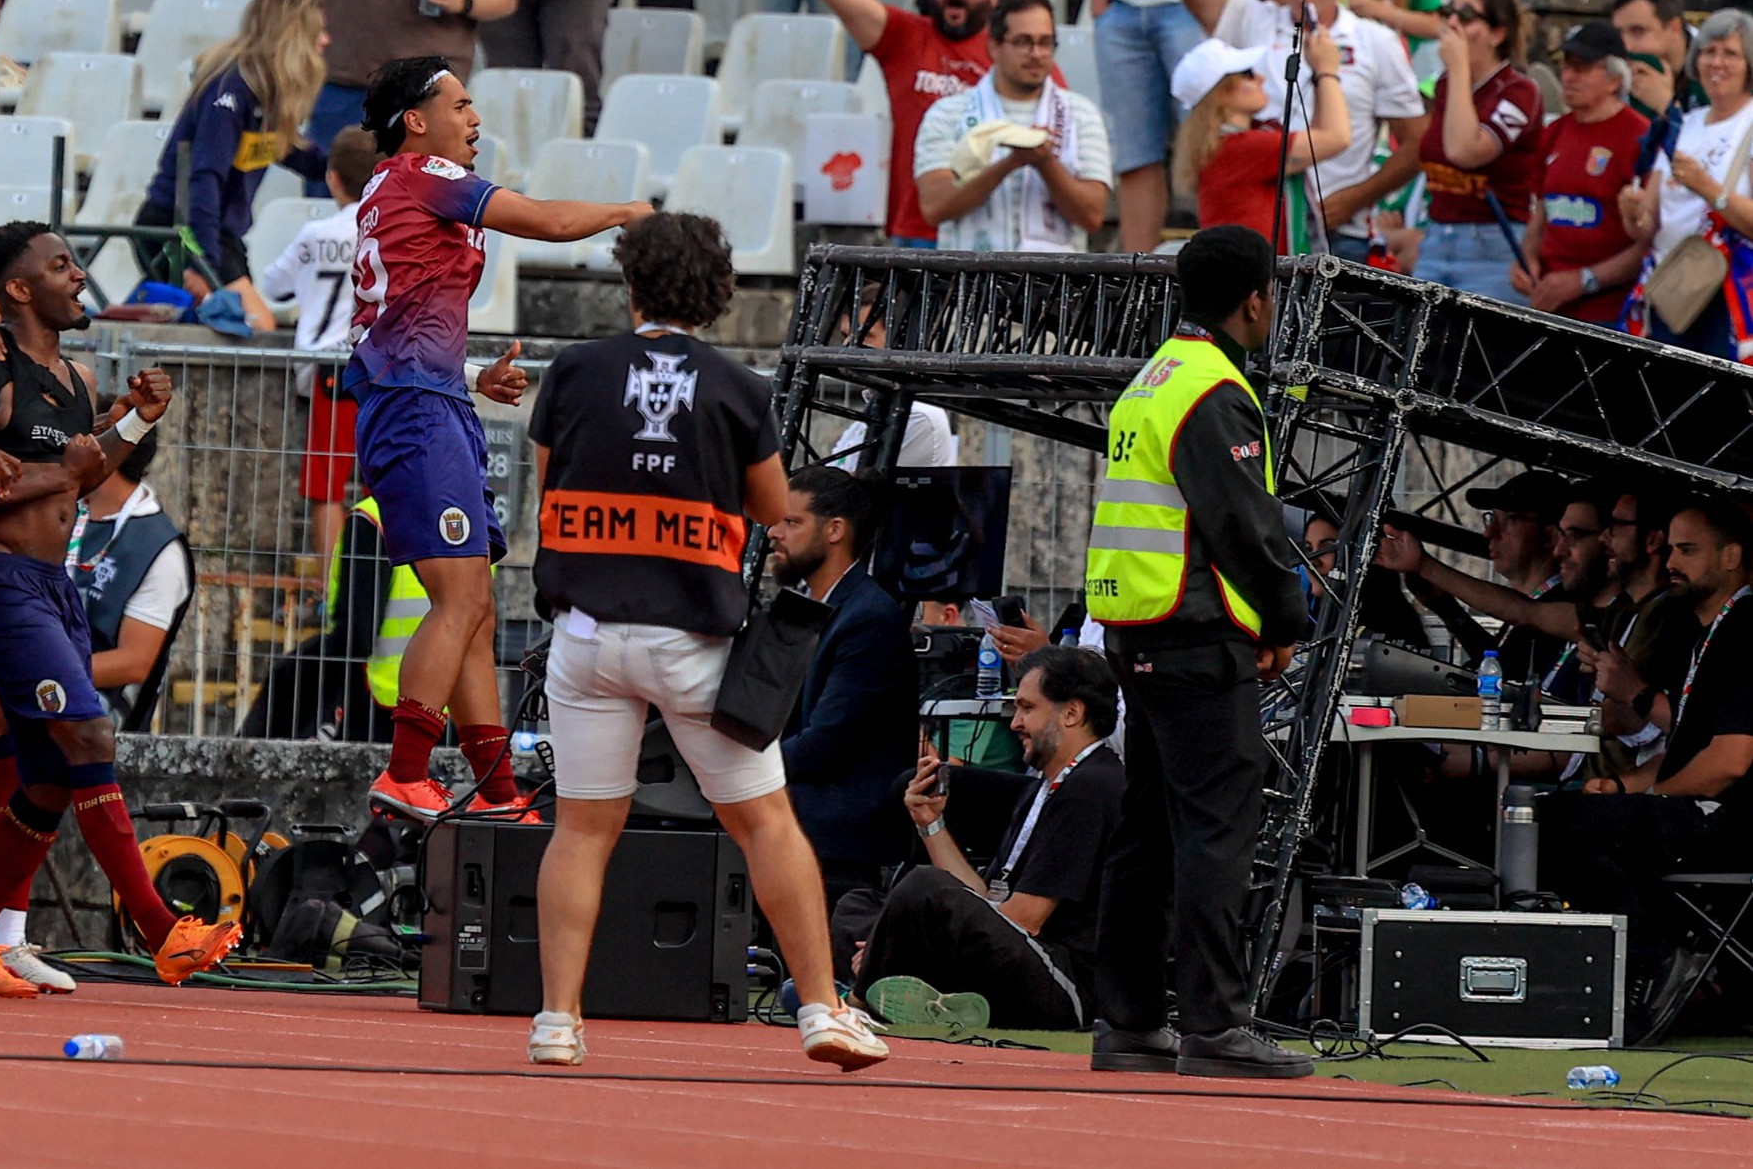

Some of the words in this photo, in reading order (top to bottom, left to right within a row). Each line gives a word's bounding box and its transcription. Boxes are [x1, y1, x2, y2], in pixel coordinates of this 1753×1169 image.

[317, 270, 347, 345] 7
[632, 452, 677, 474] FPF
[655, 510, 728, 554] MED
